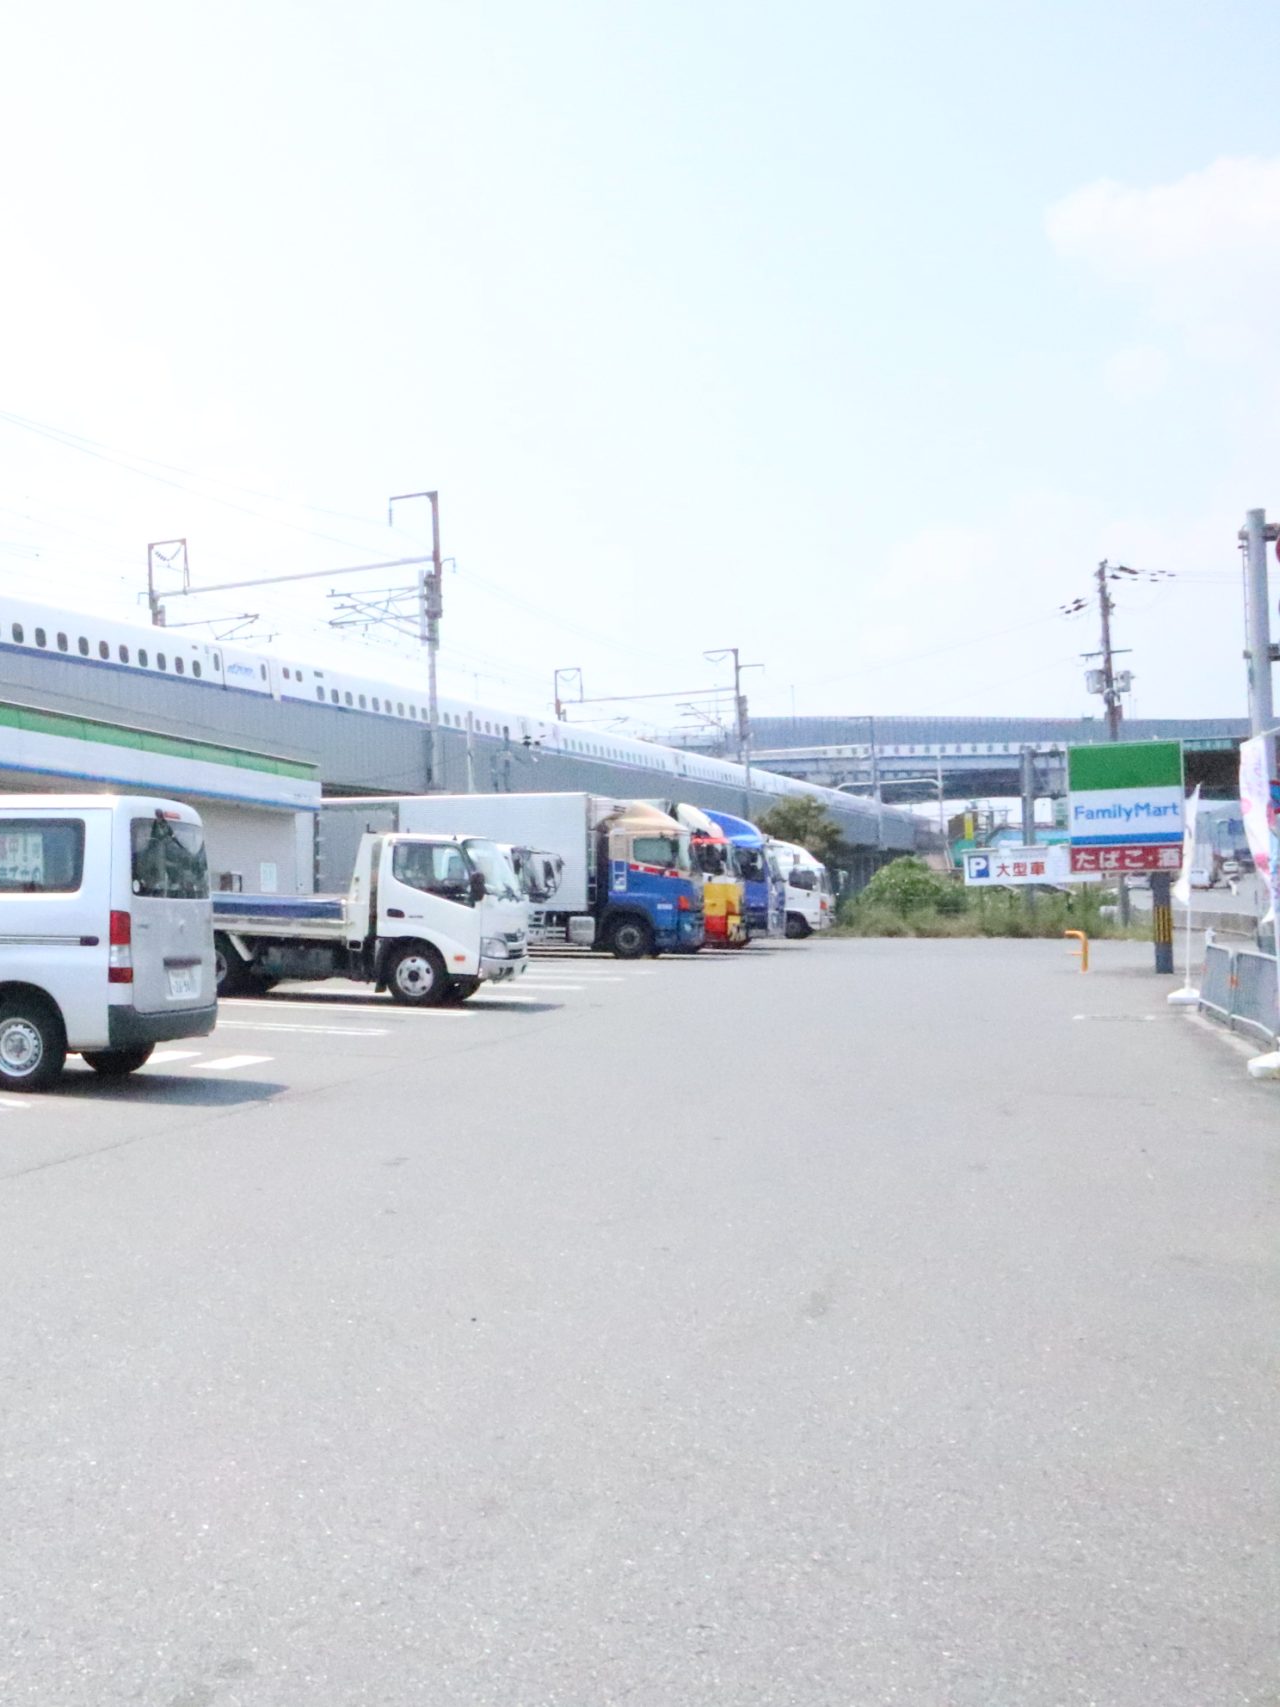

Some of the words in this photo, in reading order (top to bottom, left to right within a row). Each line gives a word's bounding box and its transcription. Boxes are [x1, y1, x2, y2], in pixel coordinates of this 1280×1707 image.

[1074, 802, 1180, 822] FamilyMart
[971, 857, 987, 878] P
[996, 861, 1046, 878] 大型車
